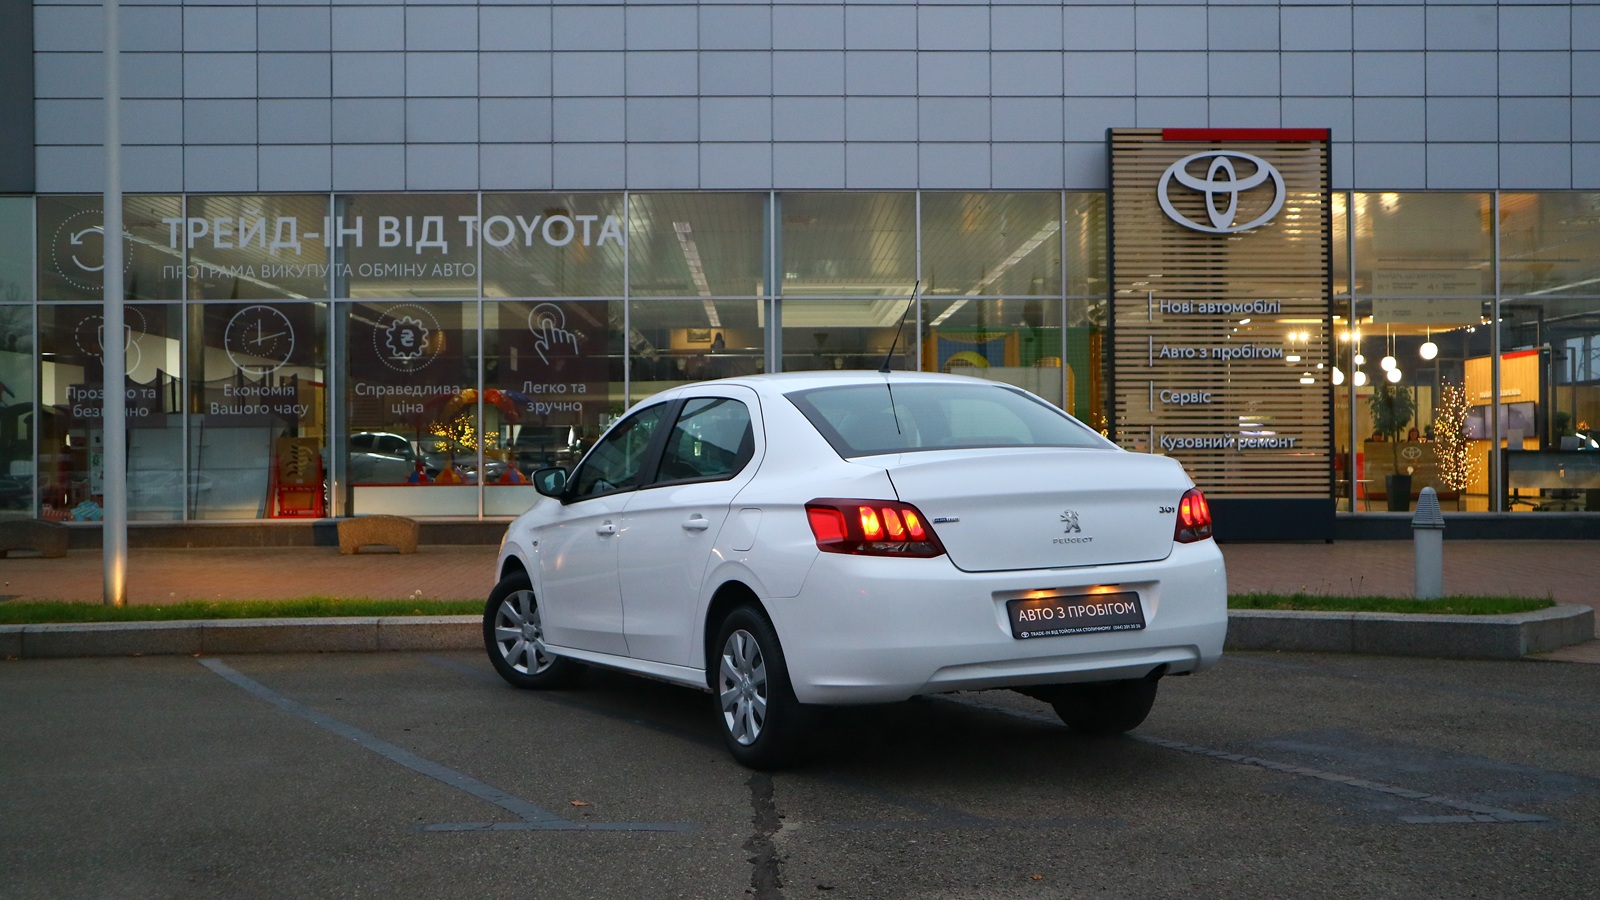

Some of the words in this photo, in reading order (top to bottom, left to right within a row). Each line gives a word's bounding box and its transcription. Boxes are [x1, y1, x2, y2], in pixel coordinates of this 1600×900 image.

[162, 209, 363, 255] ТРЕЙД-ІН
[378, 215, 448, 255] ВІД
[163, 263, 255, 279] ПРОГРАМА
[261, 263, 330, 278] ВИКУПУ
[335, 263, 354, 278] ТА
[358, 262, 427, 278] ОБМІНУ
[432, 262, 476, 278] АВТО
[1159, 299, 1194, 313] Нові
[1198, 299, 1281, 313] автомобілі
[1159, 345, 1195, 358] Авто
[1199, 347, 1207, 358] з
[1212, 344, 1283, 361] пробігом
[65, 386, 136, 402] Прозо
[140, 389, 156, 399] та
[223, 384, 295, 397] Економія
[355, 382, 460, 399] Справедлива
[522, 381, 567, 394] Легко
[572, 382, 586, 393] та
[1159, 389, 1212, 406] Сервіс
[210, 402, 269, 416] Вашого
[275, 404, 309, 418] часу
[391, 400, 424, 415] ціна
[526, 401, 583, 417] зручно
[1160, 434, 1234, 452] Кузовний
[1238, 437, 1296, 451] ремонт
[1052, 536, 1093, 544] PEUGEOT
[1019, 607, 1054, 622] АВТО
[1068, 602, 1137, 618] ПРОБІГОМ
